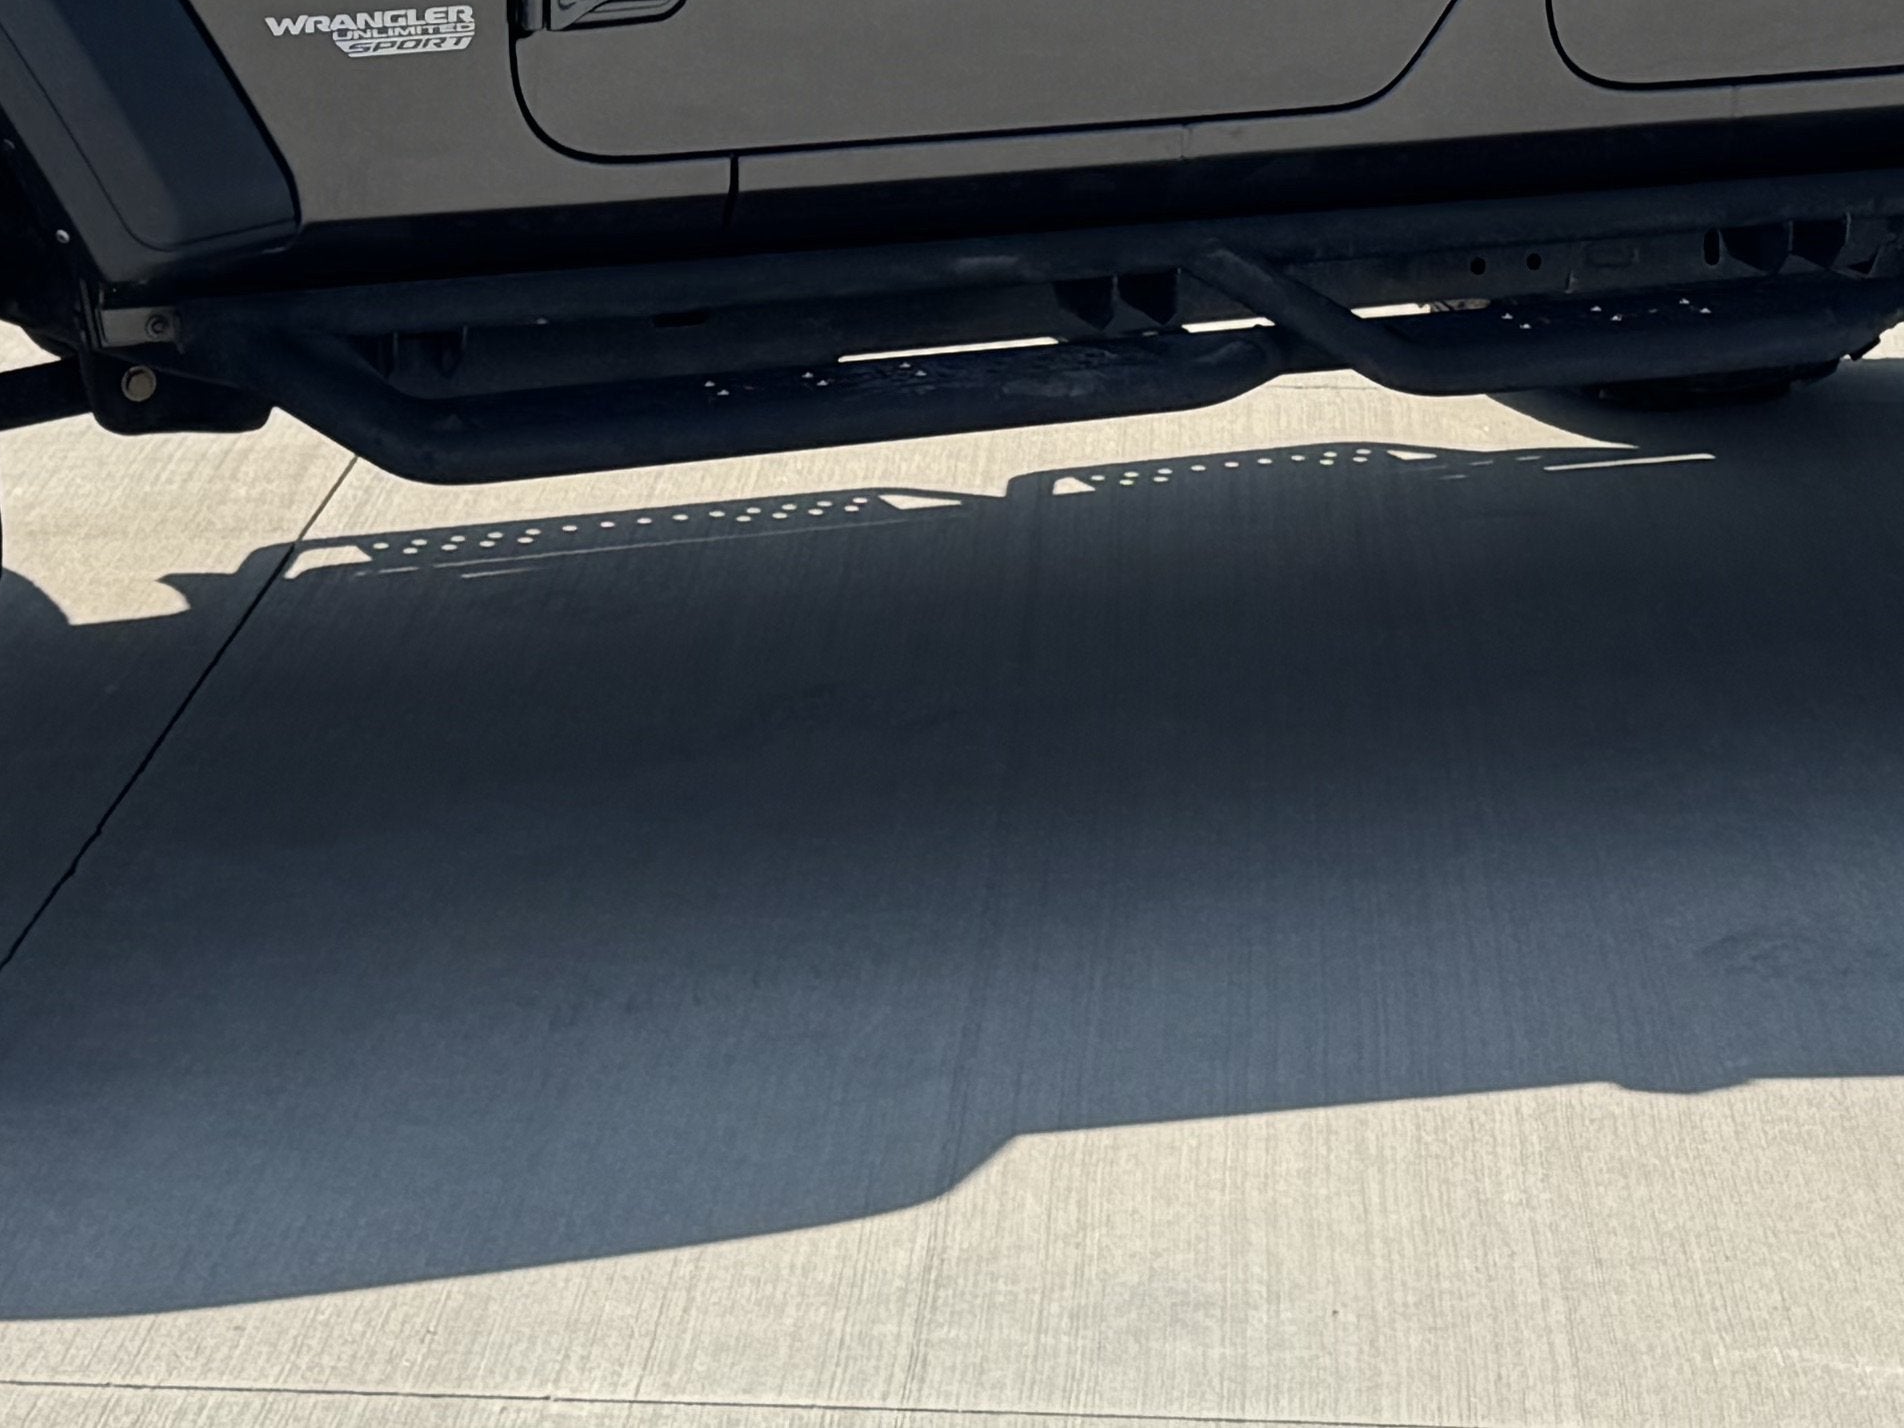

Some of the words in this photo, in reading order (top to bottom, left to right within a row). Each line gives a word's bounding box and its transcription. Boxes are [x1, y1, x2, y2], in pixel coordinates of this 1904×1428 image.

[264, 4, 475, 37] WRANGLER
[332, 22, 476, 41] UNLIMITED
[348, 34, 472, 54] SPORT
